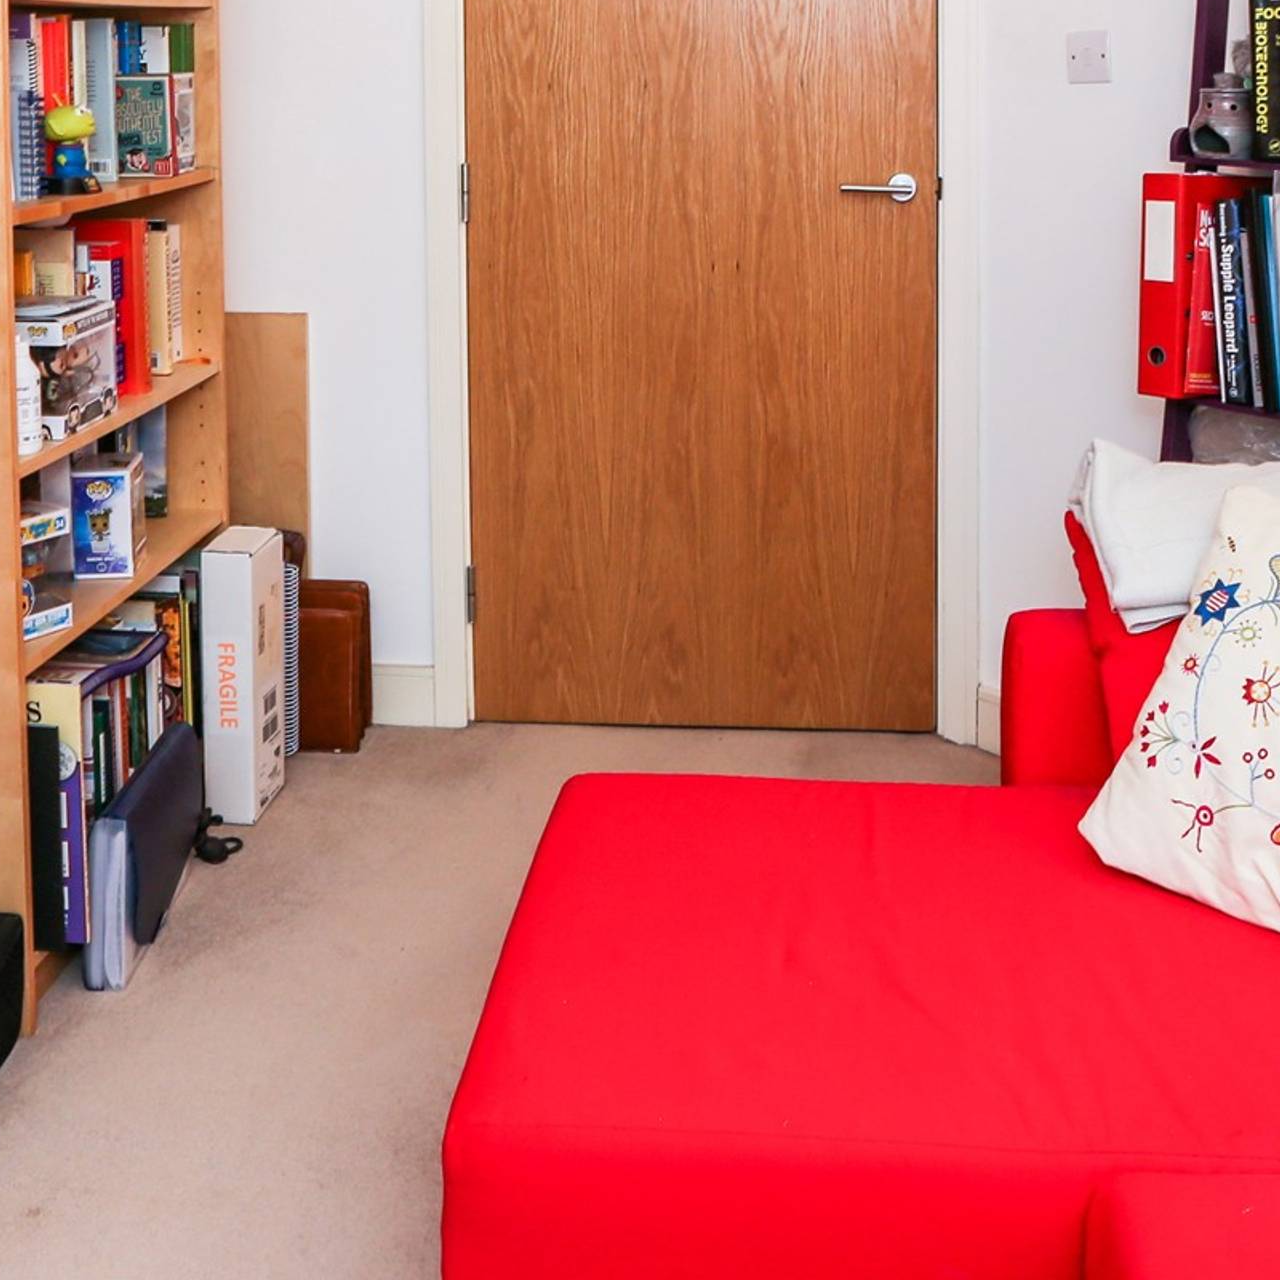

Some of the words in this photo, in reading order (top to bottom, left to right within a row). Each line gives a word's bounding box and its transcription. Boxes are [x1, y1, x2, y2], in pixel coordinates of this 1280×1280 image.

[1255, 21, 1268, 134] BIOTECHNOLOGY
[116, 99, 163, 118] BSOLUTELY
[1220, 244, 1236, 293] Supple
[1223, 297, 1239, 354] Leopard
[218, 642, 239, 729] FRAGILE
